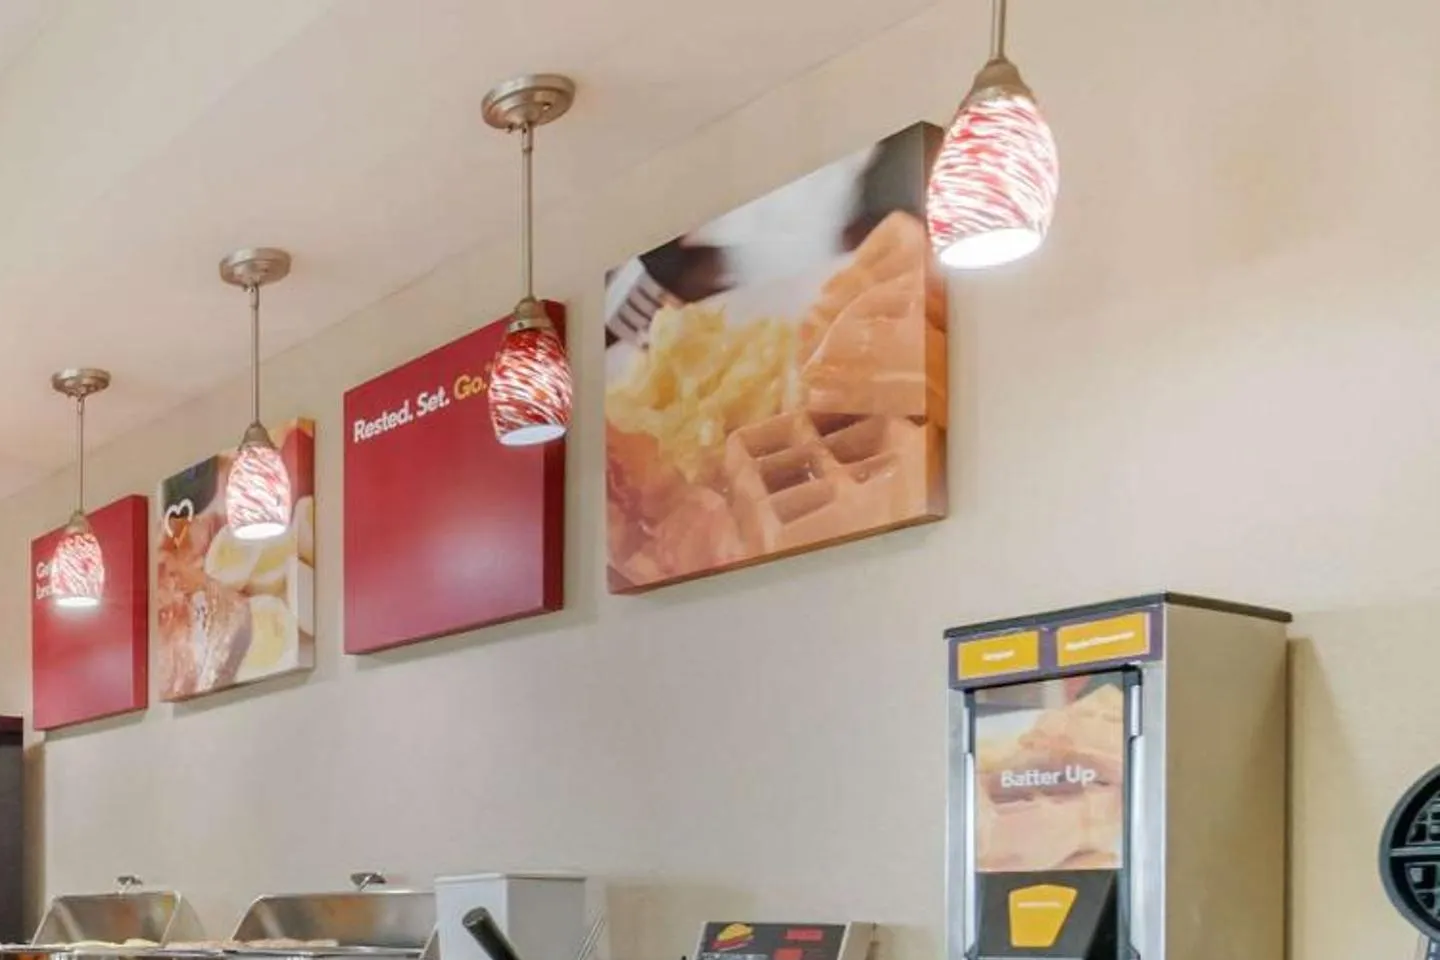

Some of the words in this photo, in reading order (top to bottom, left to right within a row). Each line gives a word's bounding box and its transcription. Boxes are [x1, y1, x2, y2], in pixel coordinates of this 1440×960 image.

[354, 400, 413, 443] Rested.
[416, 386, 450, 416] Set.
[453, 374, 487, 400] Go.
[1001, 769, 1060, 788] Batter
[1065, 764, 1095, 787] Up
